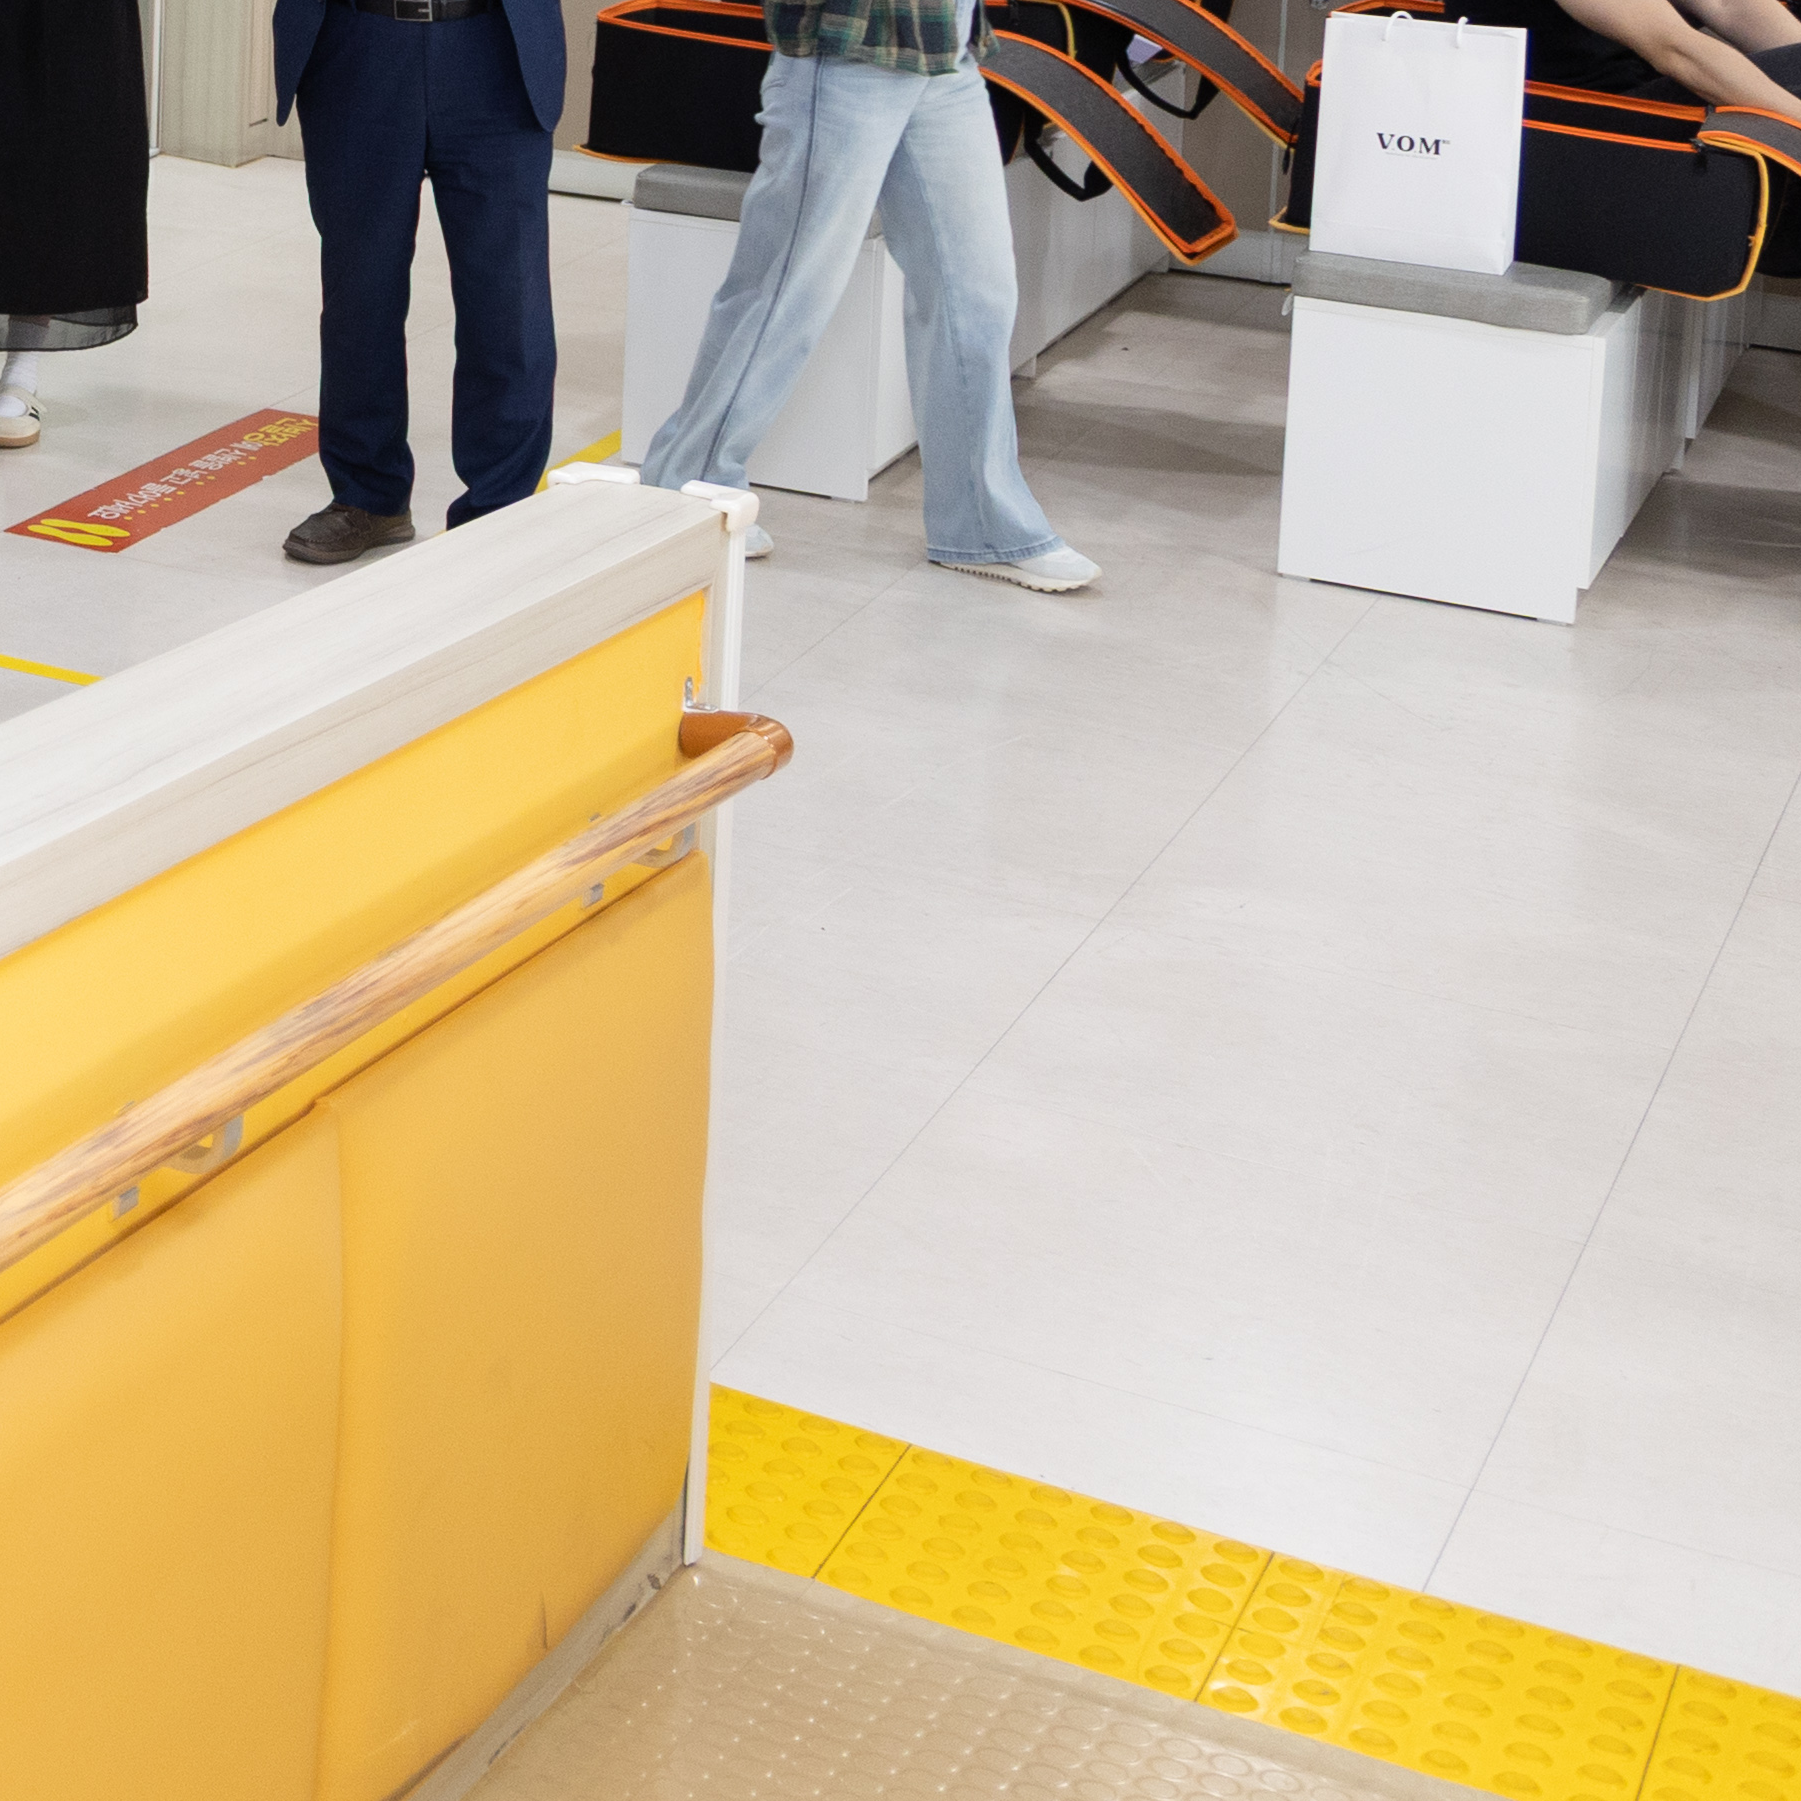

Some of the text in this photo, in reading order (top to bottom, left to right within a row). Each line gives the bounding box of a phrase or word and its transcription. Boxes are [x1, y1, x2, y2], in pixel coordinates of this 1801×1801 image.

[230, 417, 318, 451] 신발장에
[189, 448, 247, 471] 신발을
[88, 482, 177, 520] 들어가세요
